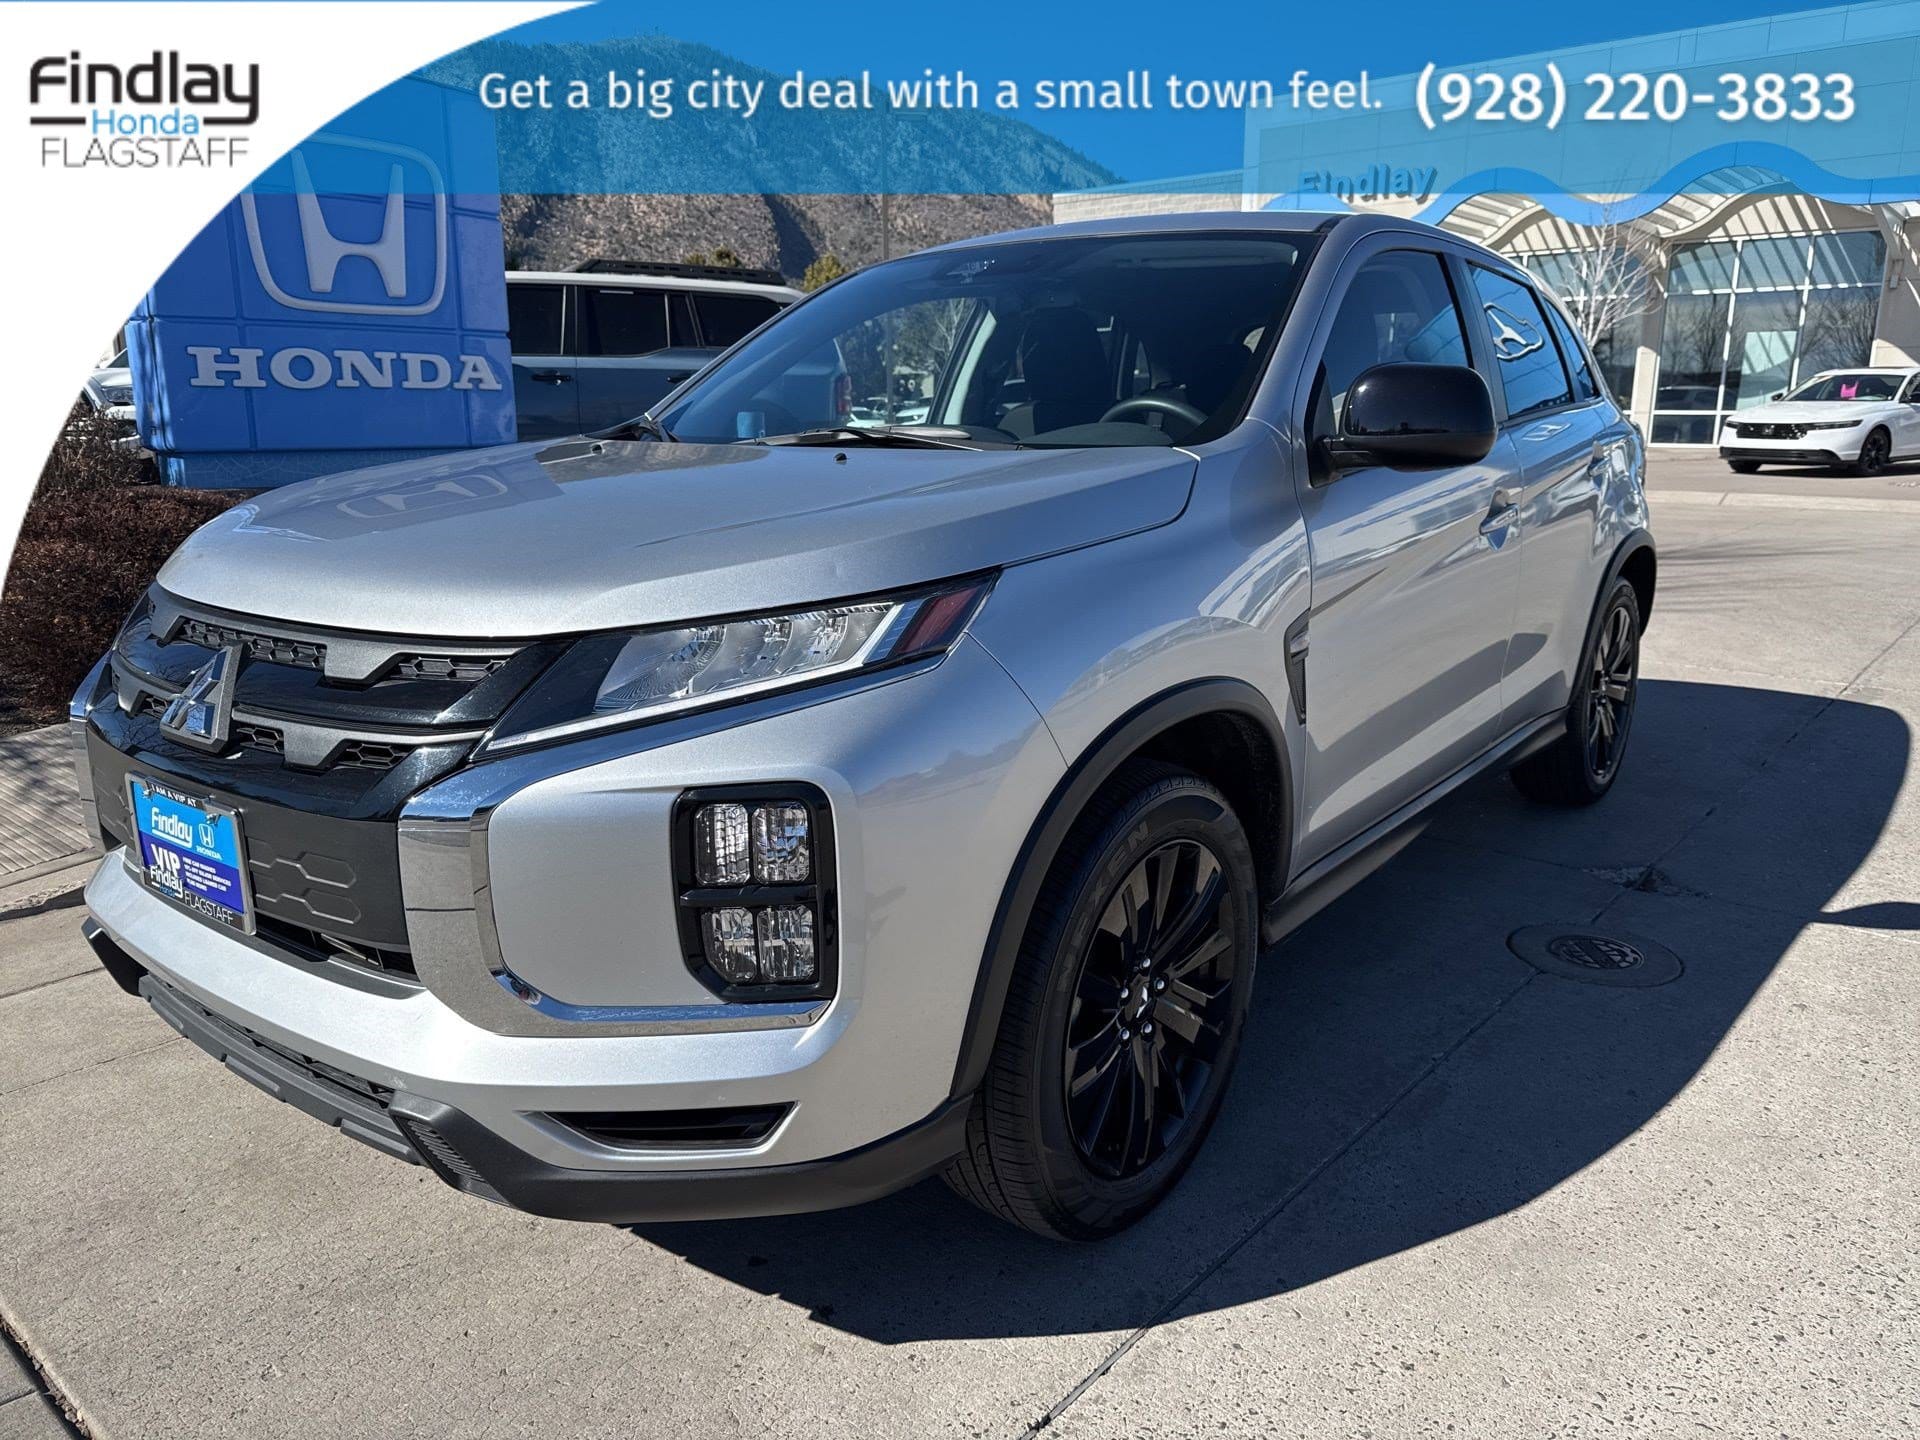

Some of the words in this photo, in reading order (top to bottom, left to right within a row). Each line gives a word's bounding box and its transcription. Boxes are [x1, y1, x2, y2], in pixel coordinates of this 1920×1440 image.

[1300, 163, 1438, 205] Findlay
[186, 345, 502, 391] HONDA
[172, 792, 186, 803] VIP
[187, 797, 197, 807] AT
[151, 807, 192, 848] Findlay
[151, 843, 181, 877] VIP
[196, 845, 223, 861] HONDA
[150, 864, 184, 899] Findlay
[184, 890, 234, 924] FLAGSTAFF
